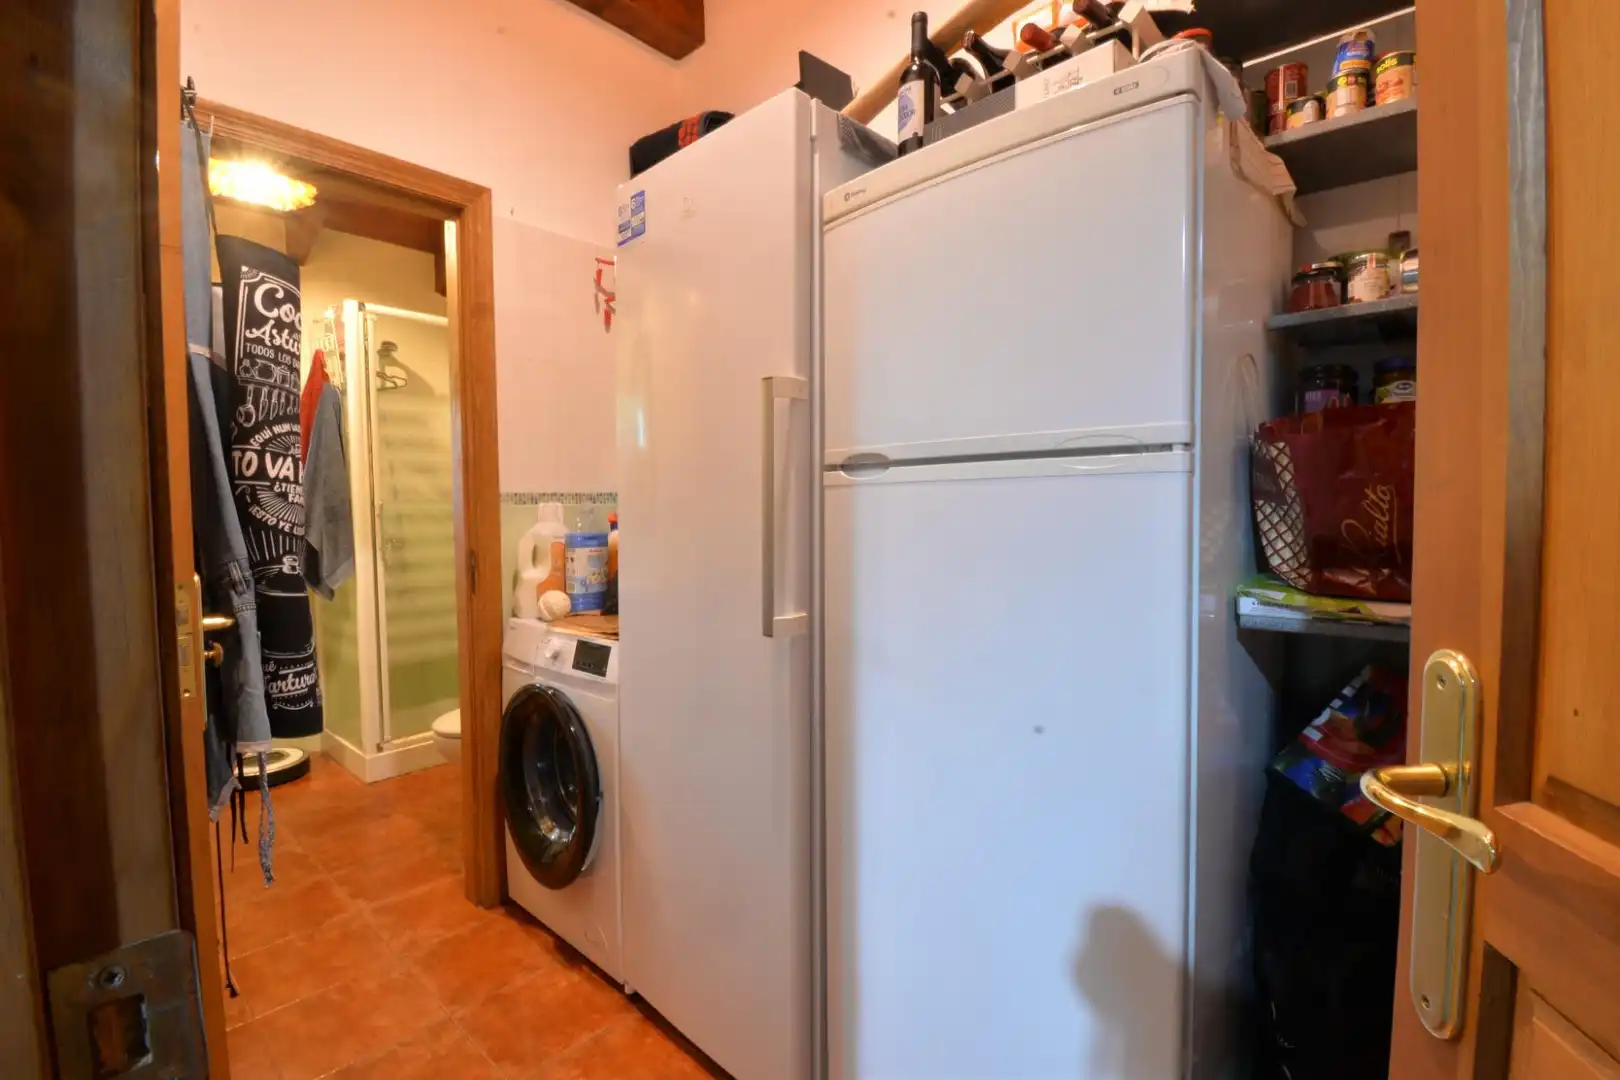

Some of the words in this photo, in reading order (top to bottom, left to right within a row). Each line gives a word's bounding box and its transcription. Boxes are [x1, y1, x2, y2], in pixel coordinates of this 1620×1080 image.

[245, 319, 301, 355] Astu
[245, 343, 275, 358] TODOS
[278, 352, 292, 365] LOS
